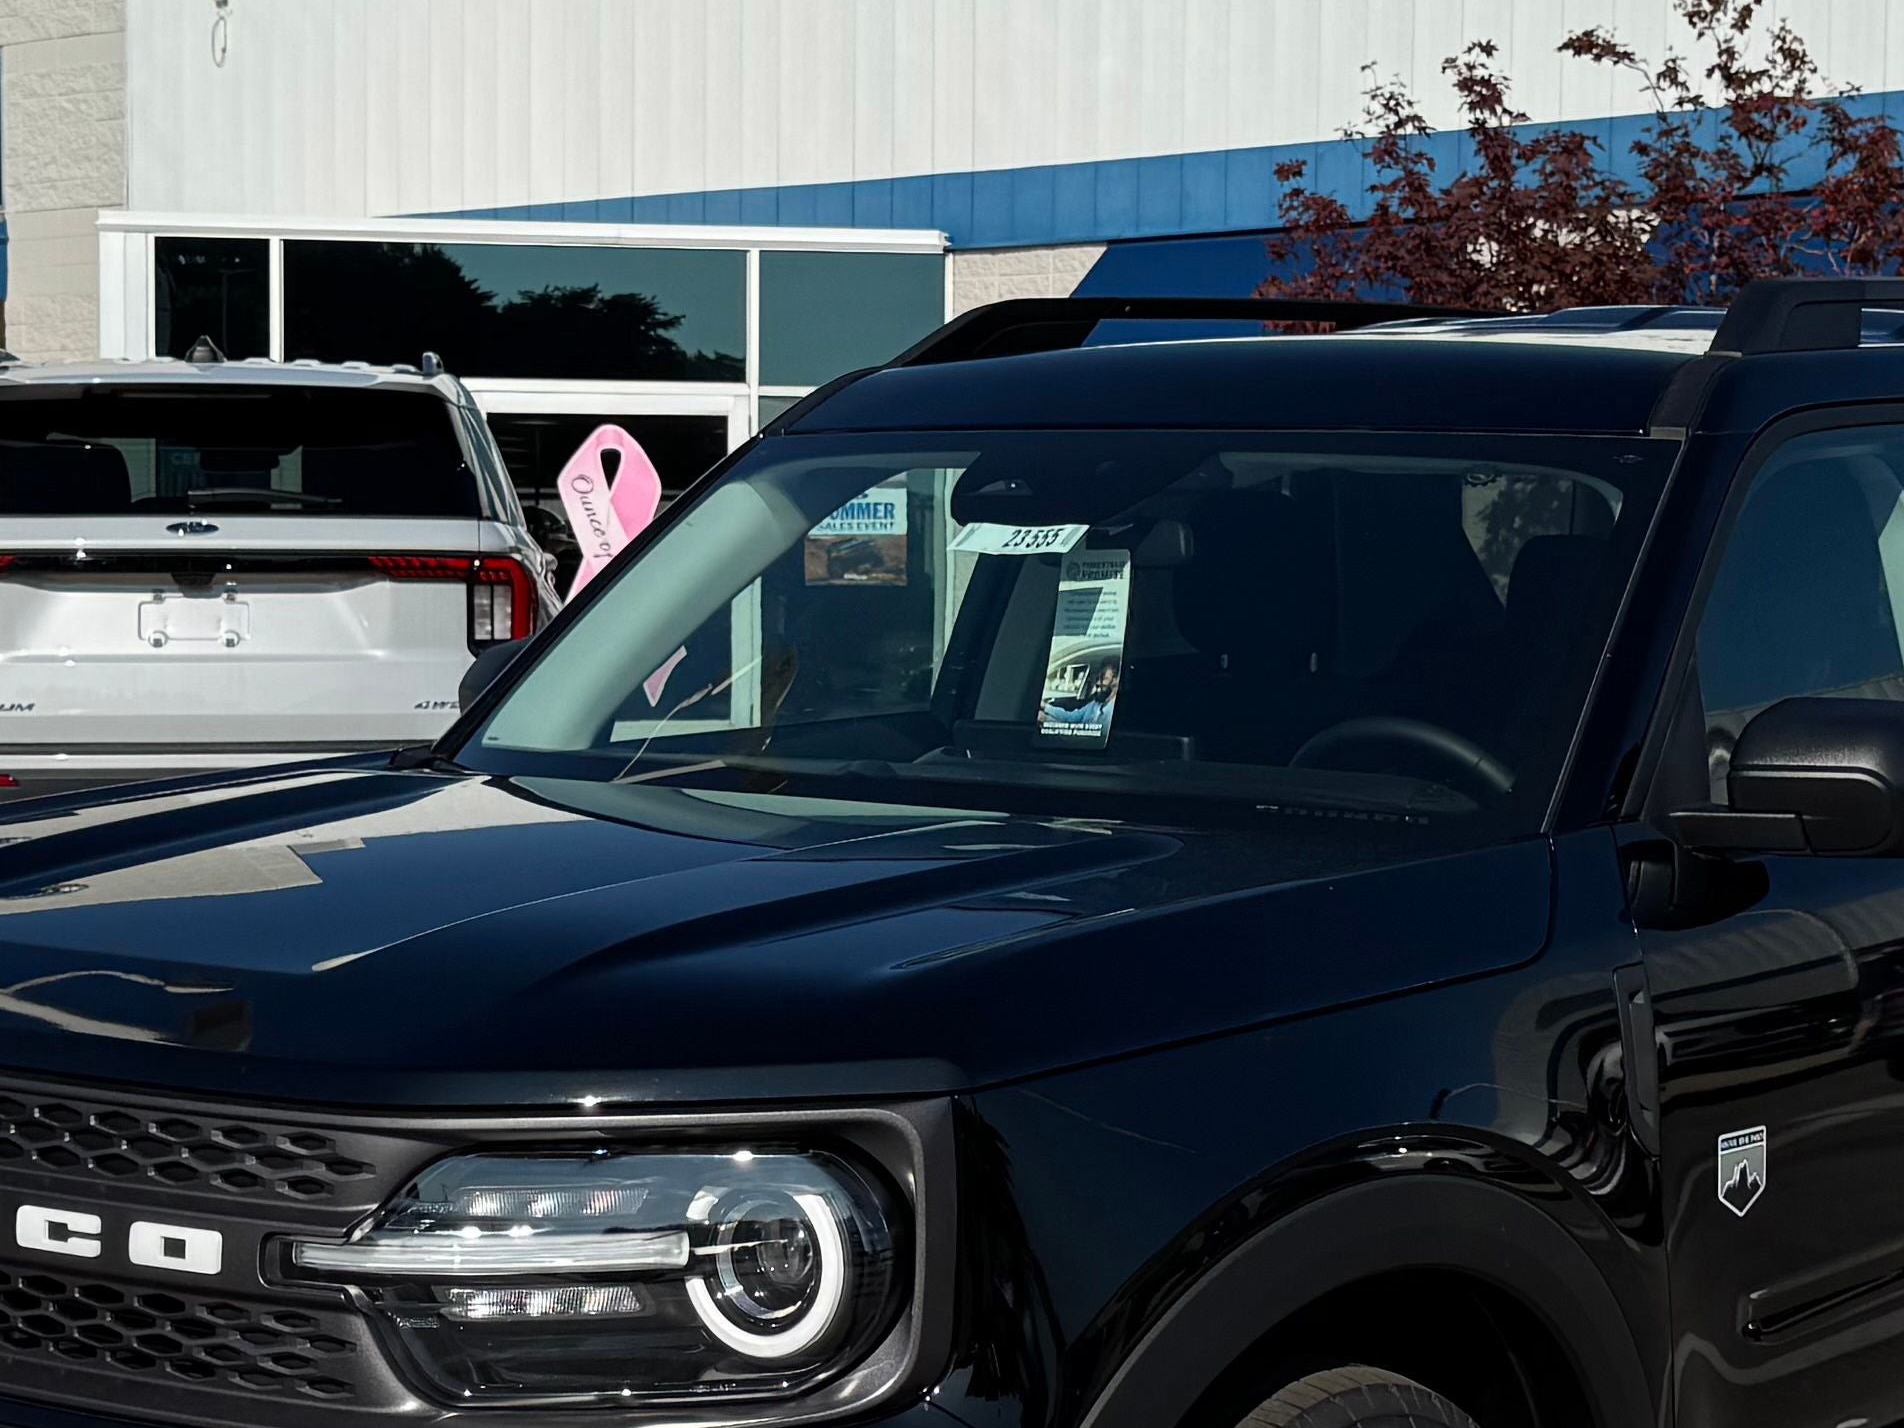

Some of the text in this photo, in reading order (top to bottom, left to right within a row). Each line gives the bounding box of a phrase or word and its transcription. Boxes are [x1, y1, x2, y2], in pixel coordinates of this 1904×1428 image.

[570, 474, 614, 560] Ounce of
[1002, 528, 1066, 548] 23555
